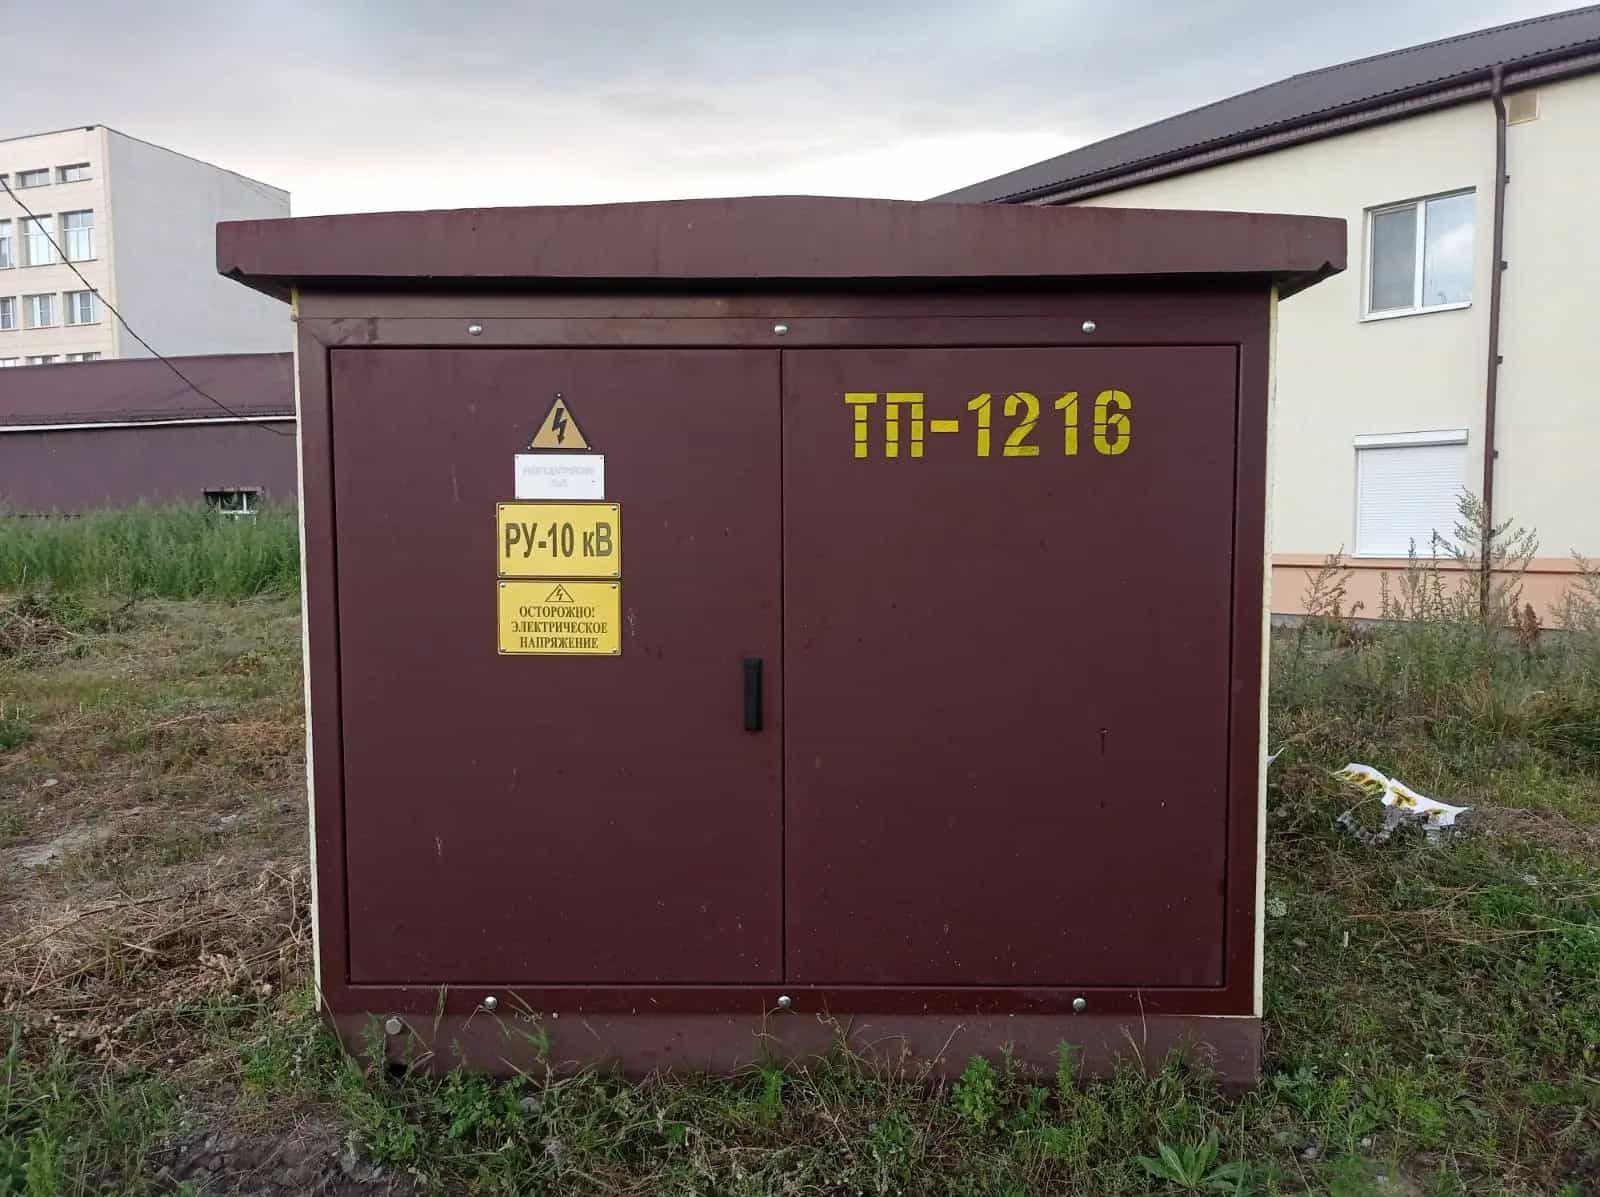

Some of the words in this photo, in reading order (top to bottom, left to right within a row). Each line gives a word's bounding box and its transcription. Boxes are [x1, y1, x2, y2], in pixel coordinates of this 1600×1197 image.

[845, 389, 1132, 458] ТП-1216
[505, 522, 574, 558] РУ-10
[583, 521, 613, 557] кВ
[519, 606, 595, 618] ОСТОРОЖНО!
[511, 621, 608, 634] ЭЛЕКТРИЧЕСКОЕ
[520, 636, 598, 649] НАПРЯЖЕНИЕ
